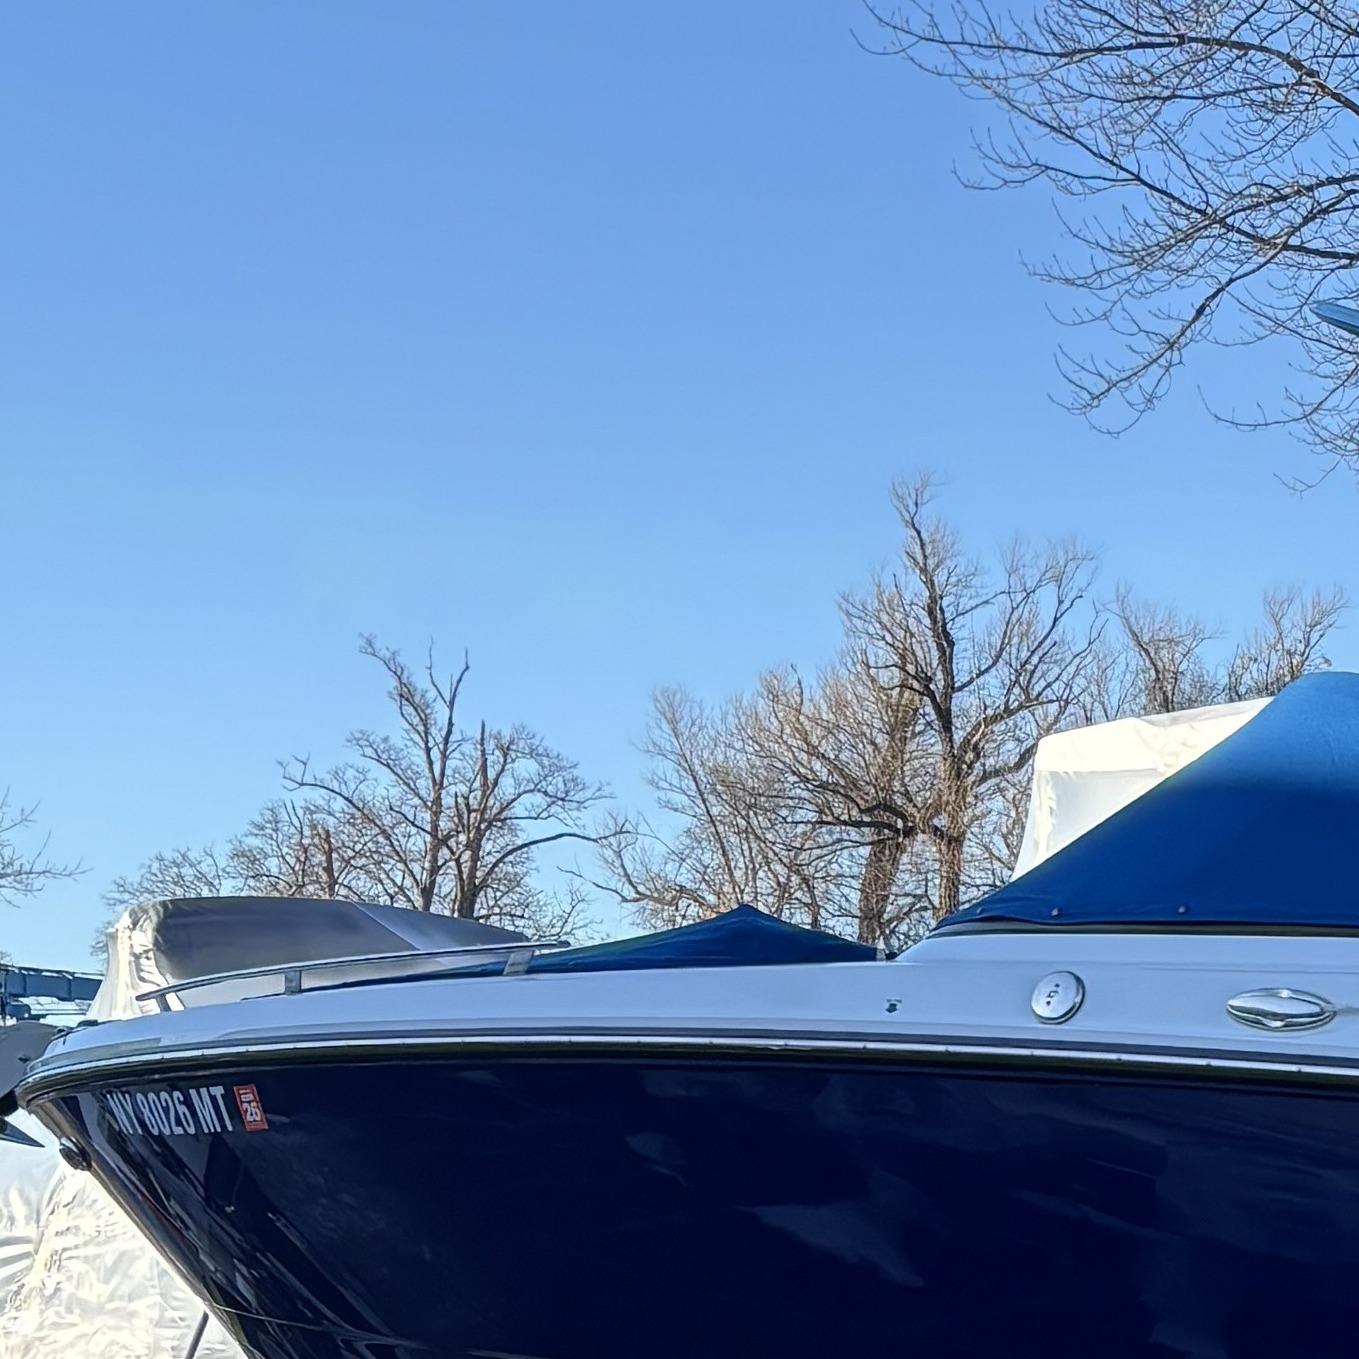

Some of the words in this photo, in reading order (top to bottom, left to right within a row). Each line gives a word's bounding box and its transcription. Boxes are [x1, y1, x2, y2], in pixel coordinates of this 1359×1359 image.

[106, 1093, 143, 1135] NY
[136, 1090, 196, 1135] 8026
[189, 1085, 233, 1133] MT
